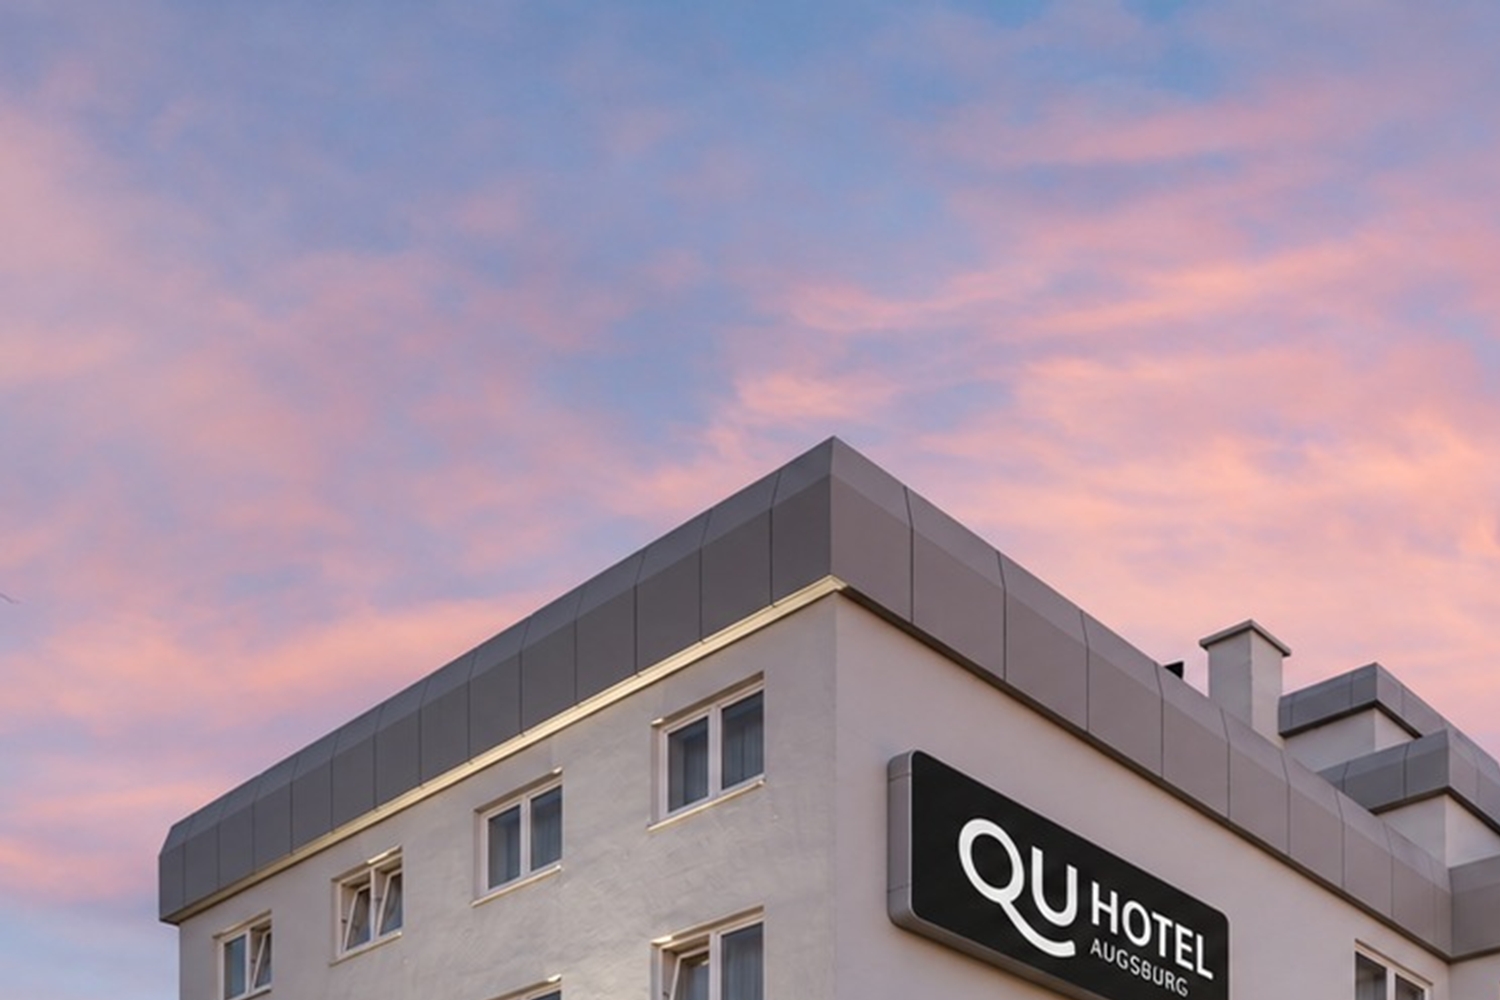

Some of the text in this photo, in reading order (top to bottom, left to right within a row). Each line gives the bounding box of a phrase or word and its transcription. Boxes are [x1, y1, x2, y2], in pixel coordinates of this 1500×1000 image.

[958, 817, 1214, 981] QU HOTEL
[1090, 938, 1189, 998] AUGSBURG
